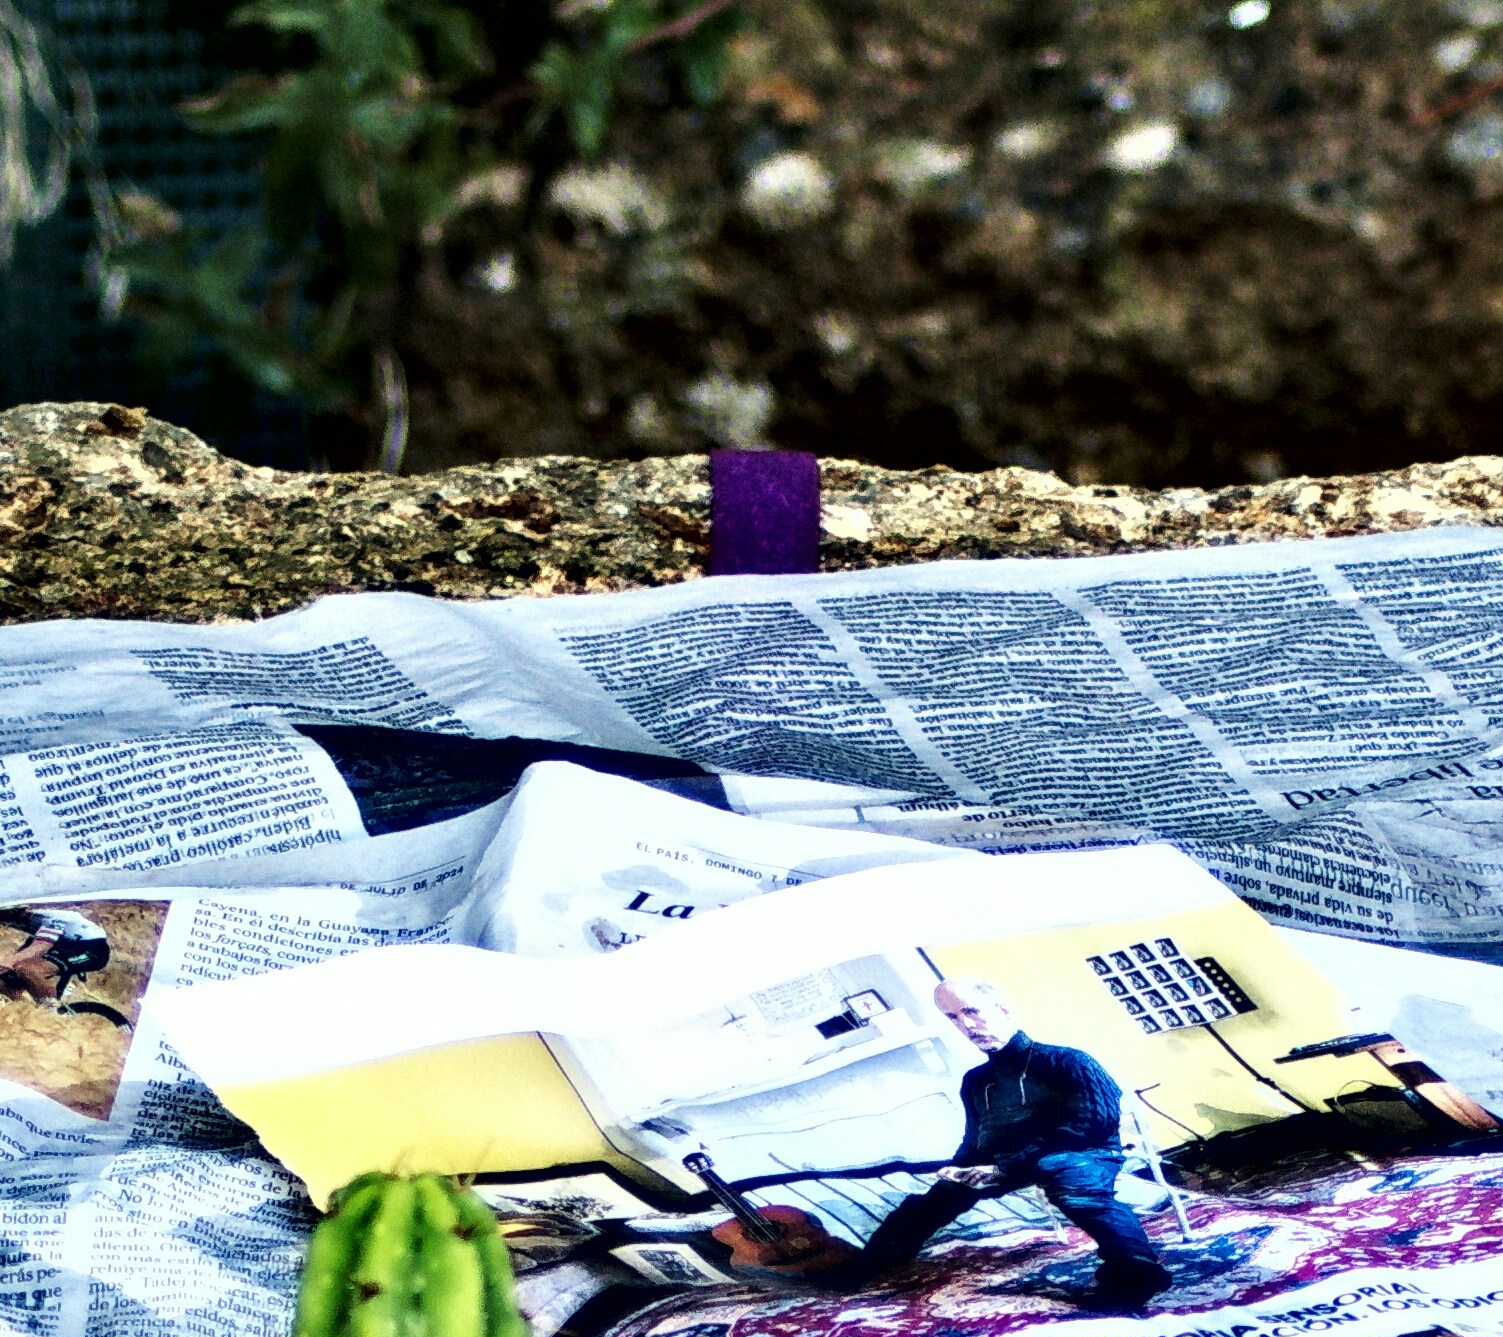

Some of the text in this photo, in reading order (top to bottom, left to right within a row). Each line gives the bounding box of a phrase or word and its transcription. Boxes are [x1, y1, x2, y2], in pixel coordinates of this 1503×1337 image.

[1278, 760, 1474, 812] libertad
[636, 841, 653, 853] EL
[705, 859, 763, 881] DOMINGO
[270, 913, 290, 922] en
[297, 916, 311, 927] la
[623, 889, 695, 922] La
[1255, 1280, 1430, 1326] SENSORIAL
[1368, 1297, 1426, 1320] LOS
